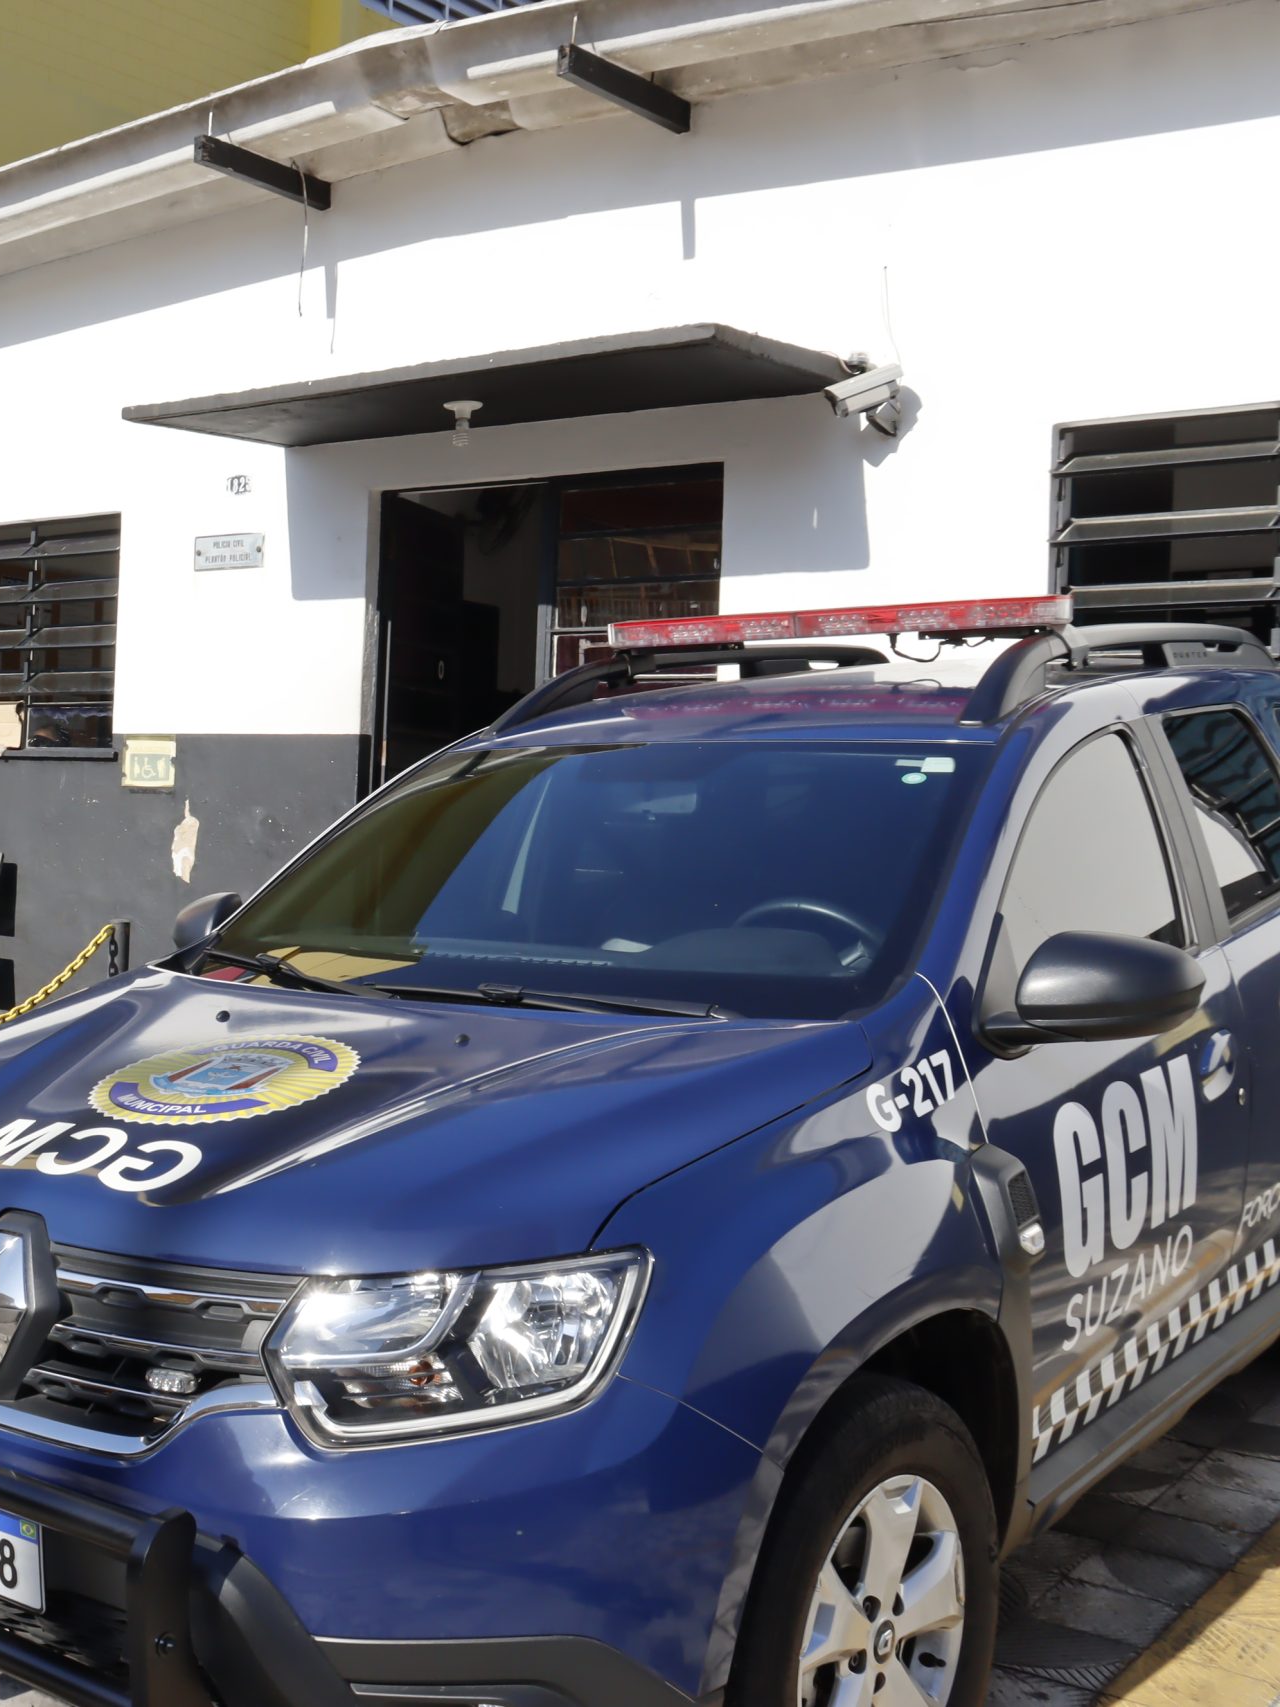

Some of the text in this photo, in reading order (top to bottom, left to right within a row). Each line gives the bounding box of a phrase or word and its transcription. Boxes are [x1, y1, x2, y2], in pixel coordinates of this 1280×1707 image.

[214, 1040, 303, 1052] GUARDA
[866, 1049, 955, 1132] G-217
[1053, 1053, 1198, 1278] GCM
[1061, 1225, 1193, 1351] SUZANO
